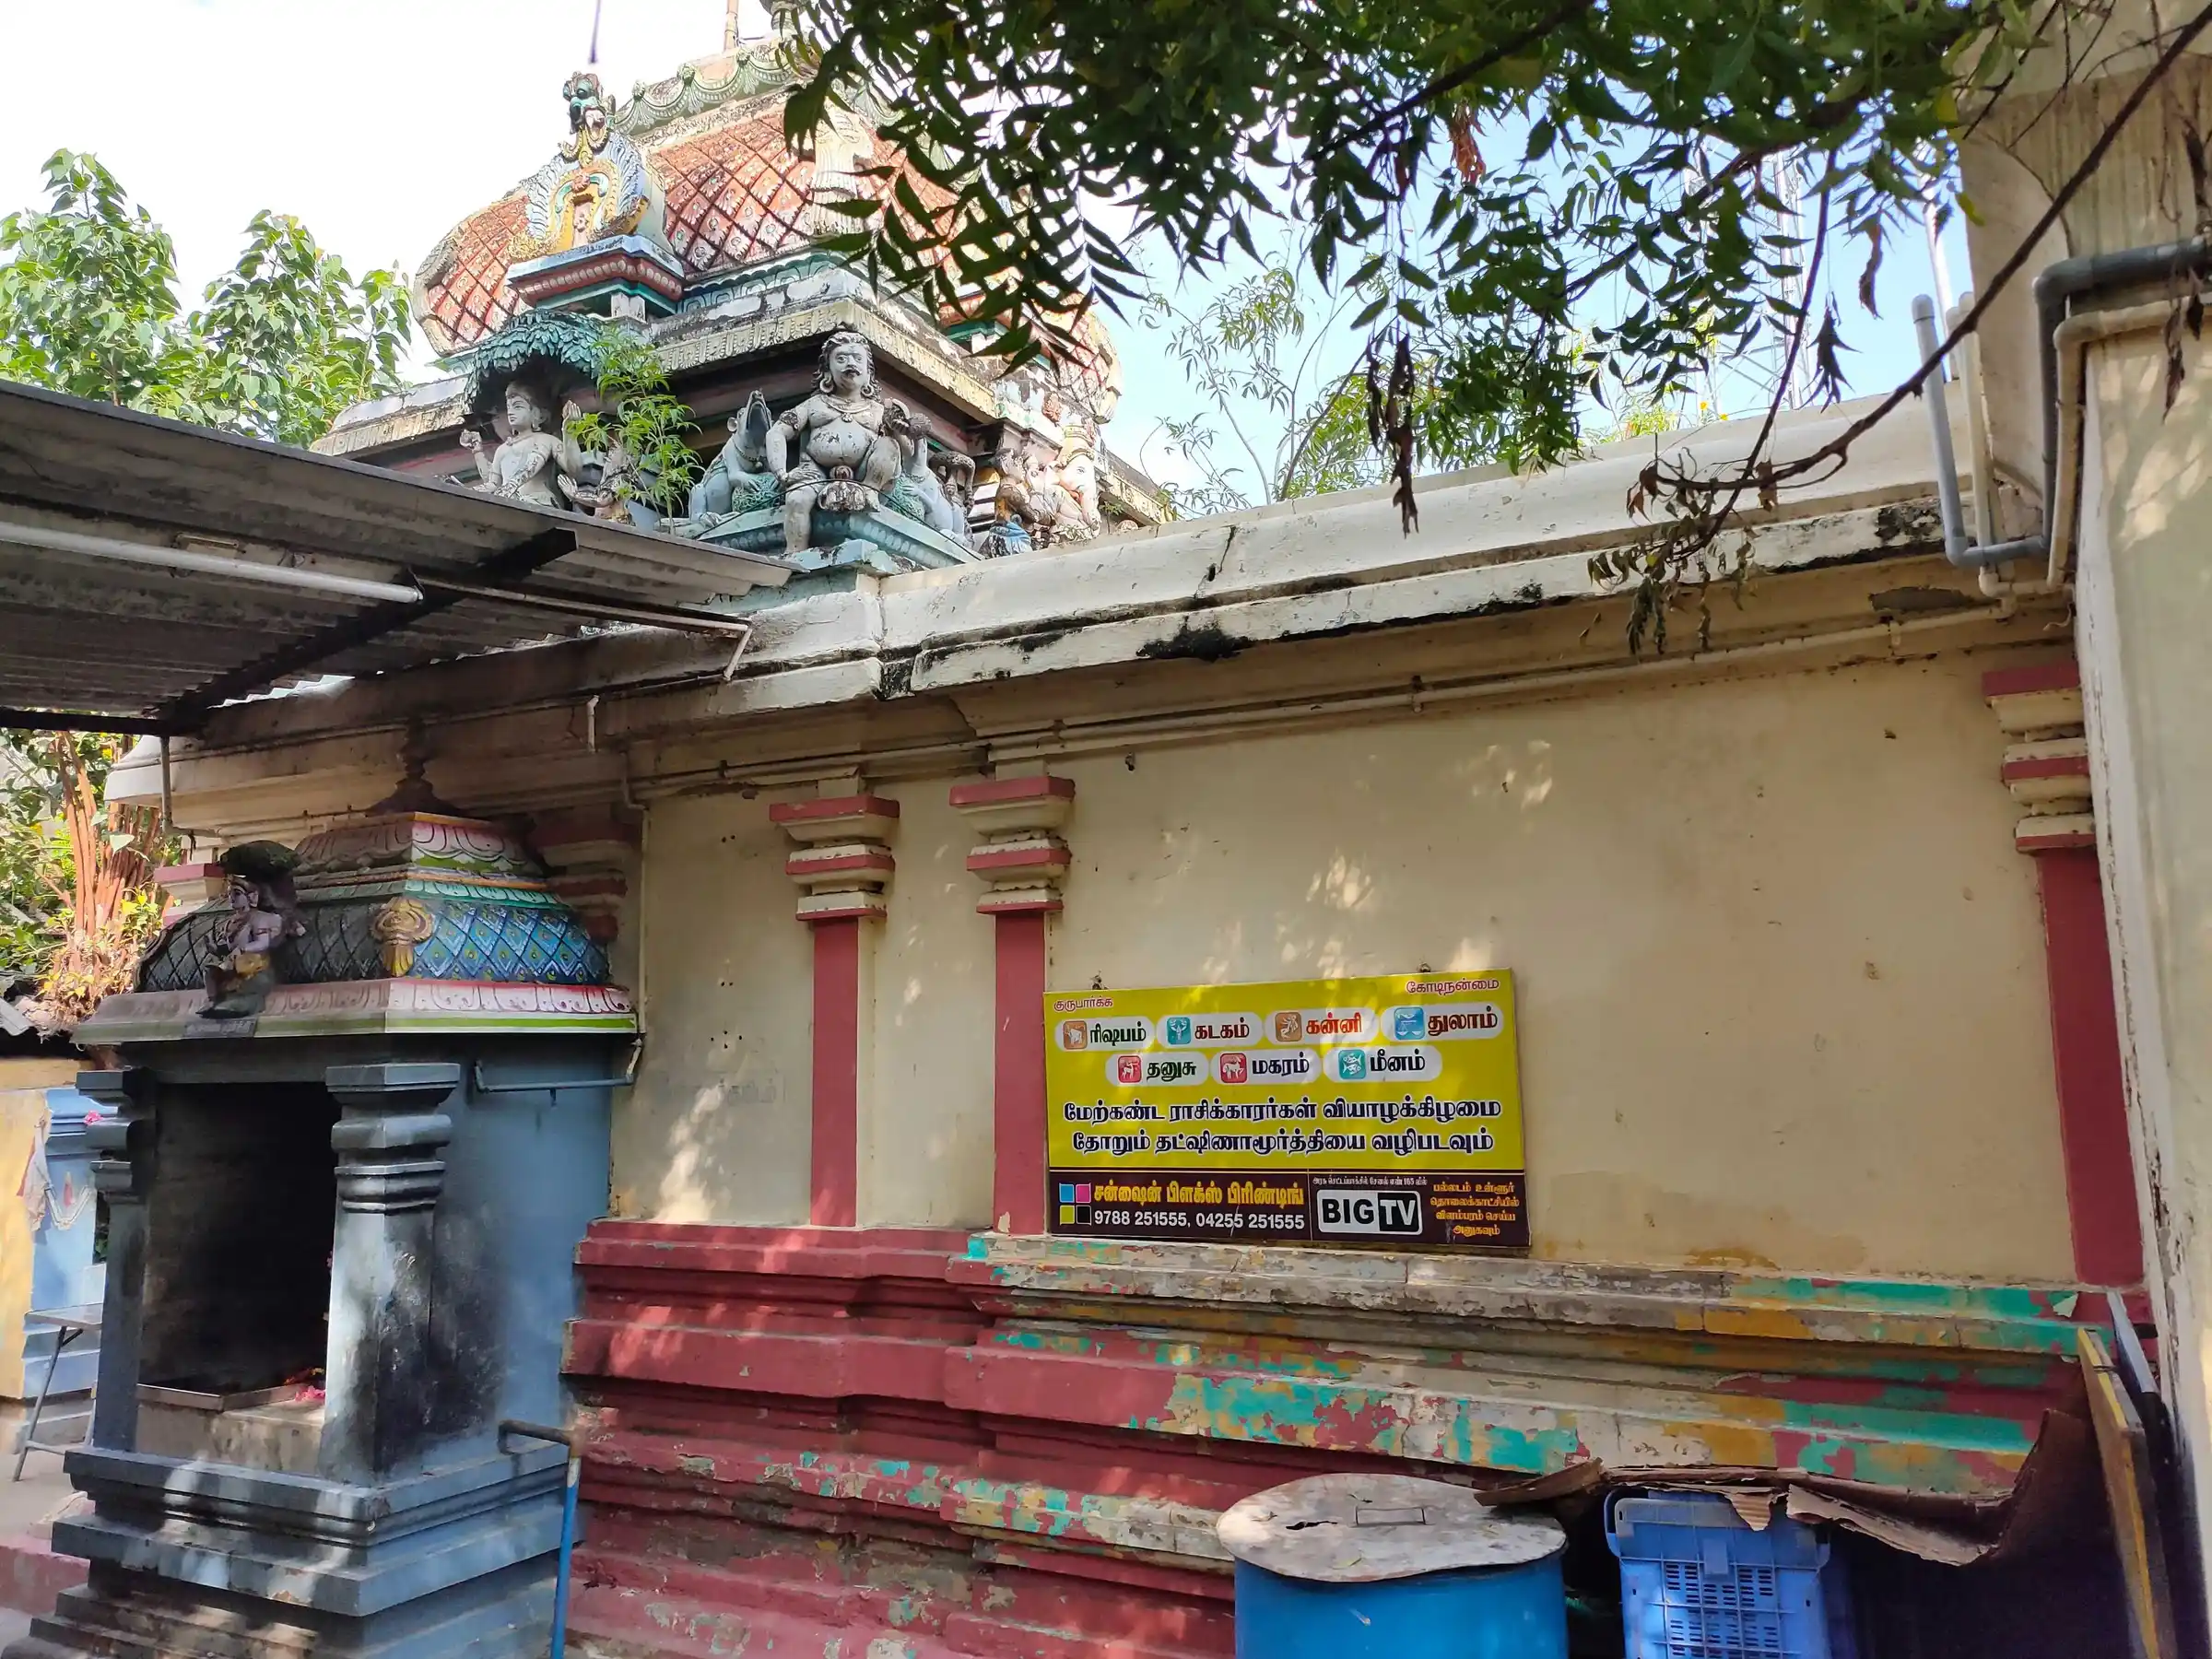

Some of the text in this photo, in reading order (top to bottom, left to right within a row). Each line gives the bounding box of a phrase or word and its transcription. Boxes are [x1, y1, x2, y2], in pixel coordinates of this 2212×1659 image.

[1053, 995, 1113, 1012] குருபார்க்க
[1089, 1006, 1498, 1047] ரிஷபம் கடகம் கன்னி துலாம்
[1147, 1049, 1426, 1082] தனுசு மகரம் மீனம்
[1064, 1095, 1501, 1125] மேற்கண்ட ராசிக்காரர்கள் வியாழக்கிழமை
[1073, 1127, 1494, 1156] தோறும் தட்ஷிணாமூர்த்தியை வழிபடவும்
[1094, 1179, 1305, 1209] சன்ஷைன் பிளக்ஸ் பிரிண்டிங்
[1094, 1210, 1305, 1230] 9788 251555, 04255 251555
[1436, 1209, 1516, 1221] விளம்பரம் செய்ய
